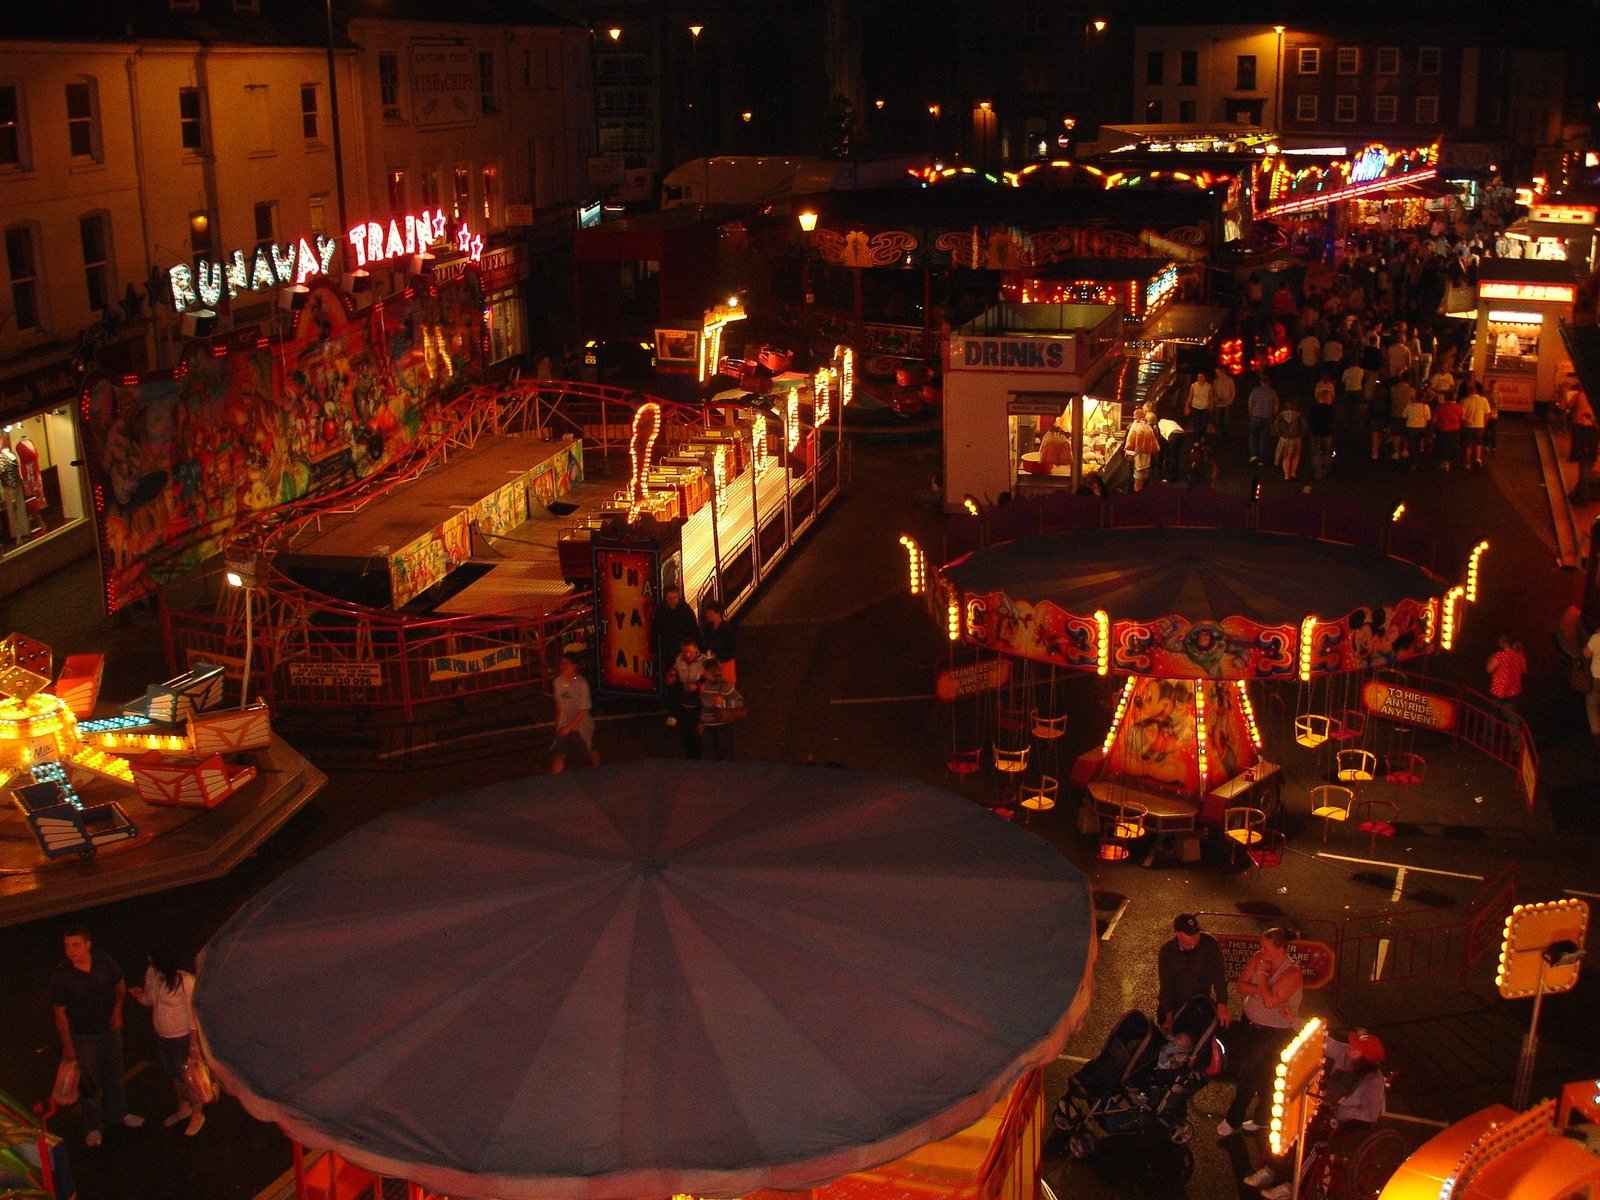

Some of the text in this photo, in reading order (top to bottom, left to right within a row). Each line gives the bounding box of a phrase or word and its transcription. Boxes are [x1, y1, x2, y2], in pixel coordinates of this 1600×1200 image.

[168, 209, 435, 314] RUNAWAY TRAIN
[964, 340, 1064, 369] DRINKS
[295, 677, 372, 686] 07967 320 096
[1385, 696, 1432, 715] ANY RIDE
[1388, 687, 1429, 705] TO HIRE
[1380, 704, 1437, 726] ANY EVENT
[1228, 941, 1247, 949] THIS
